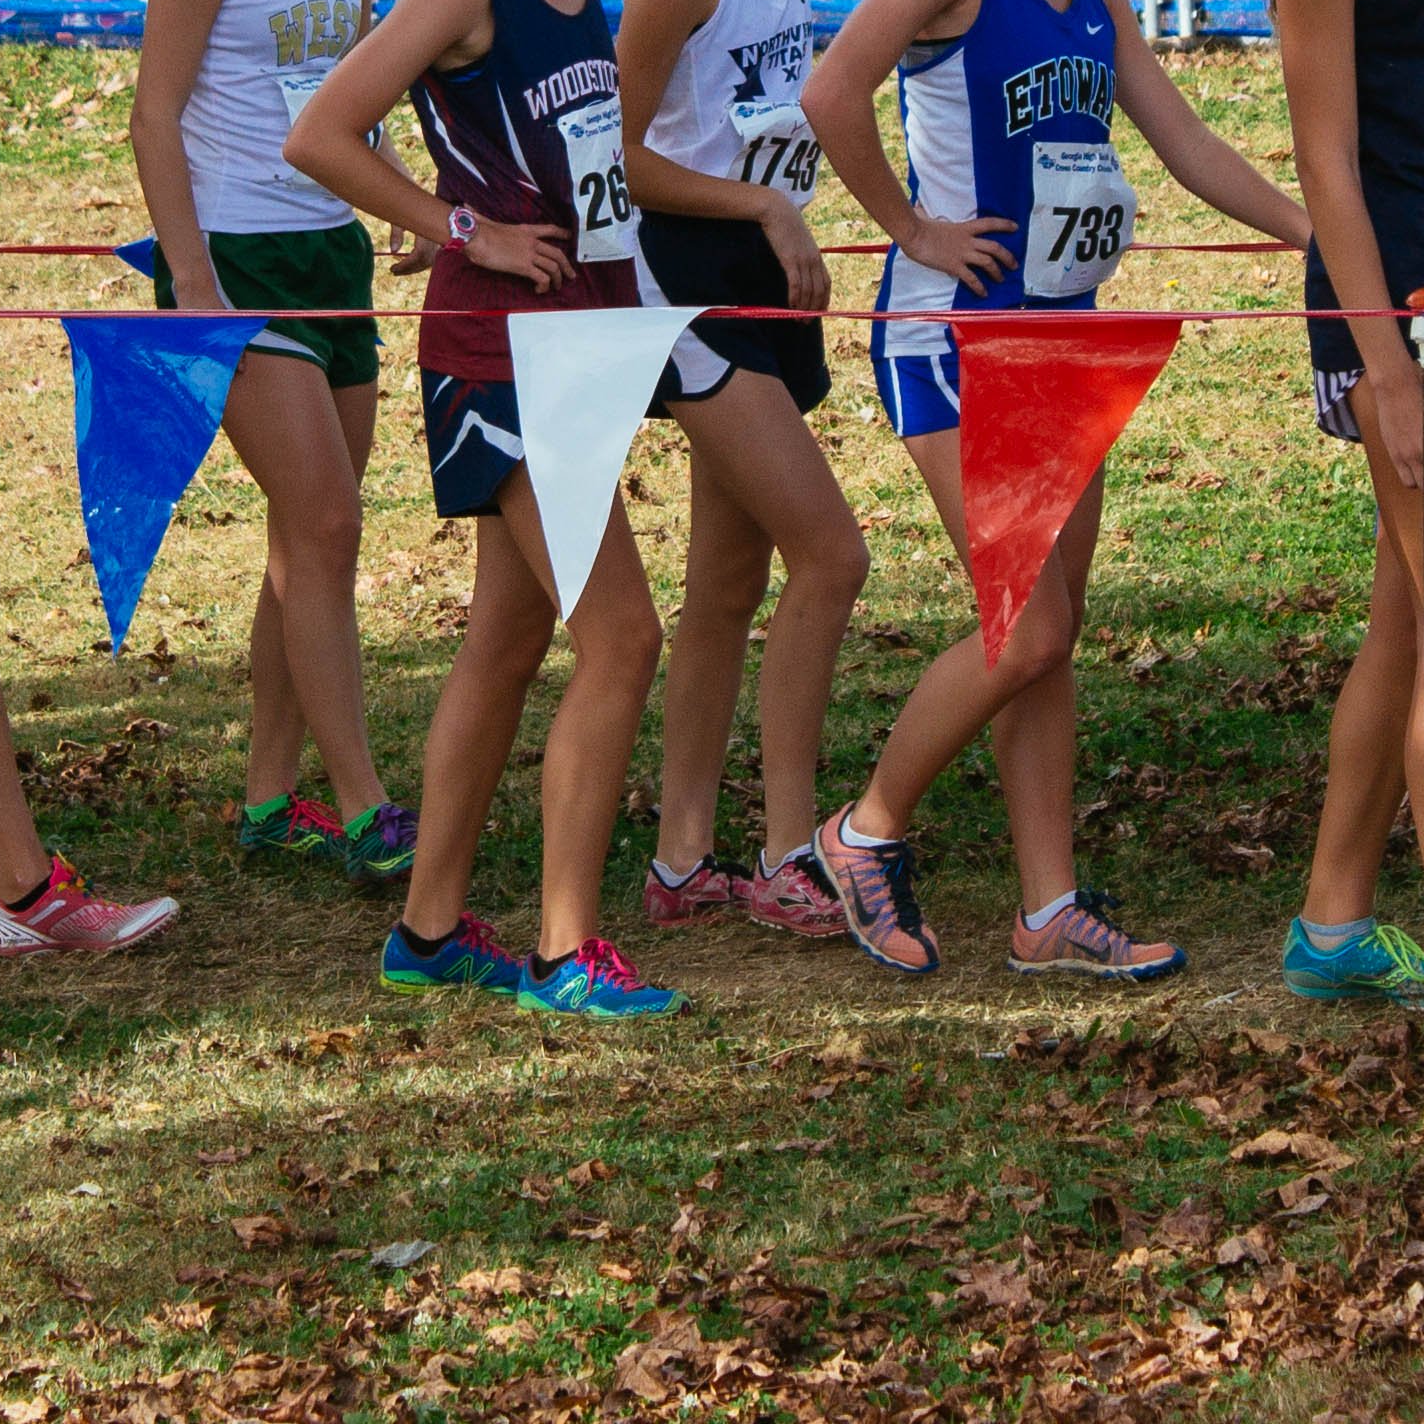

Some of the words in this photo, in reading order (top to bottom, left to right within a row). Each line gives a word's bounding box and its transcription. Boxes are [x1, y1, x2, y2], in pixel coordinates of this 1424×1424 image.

[768, 40, 807, 70] TITA
[741, 136, 822, 193] 1743
[579, 164, 634, 232] 26
[1047, 204, 1124, 263] 733
